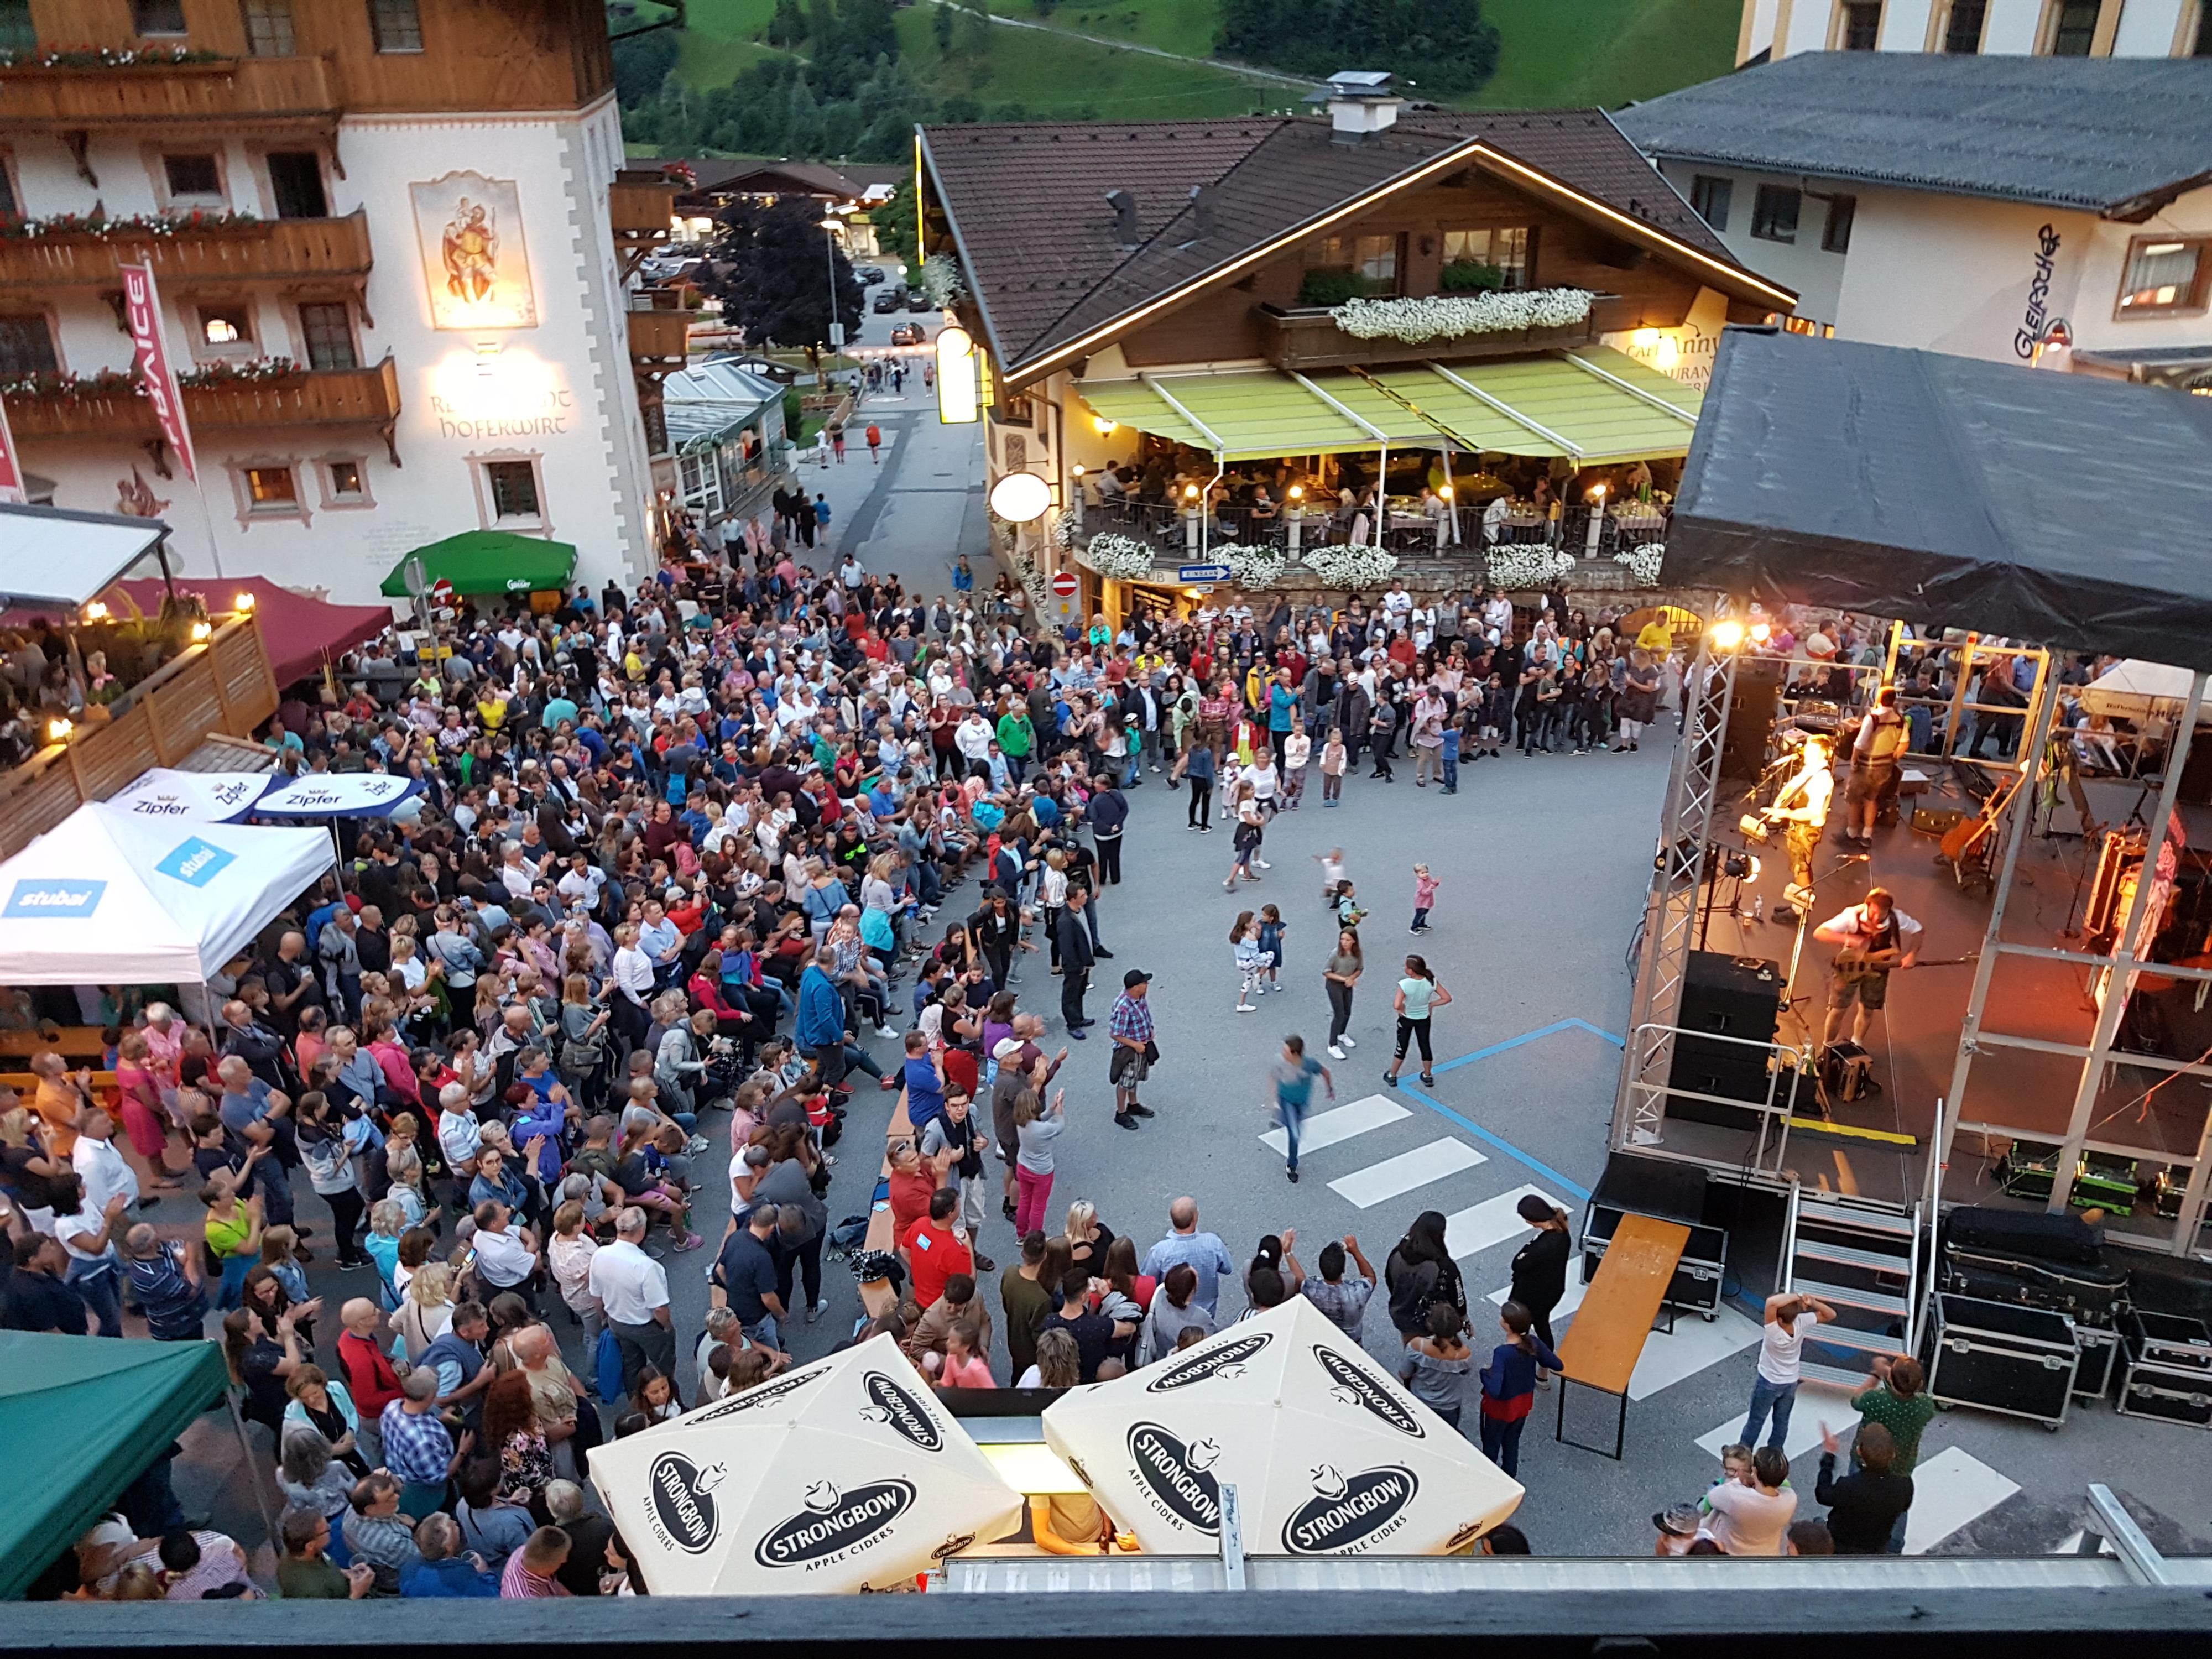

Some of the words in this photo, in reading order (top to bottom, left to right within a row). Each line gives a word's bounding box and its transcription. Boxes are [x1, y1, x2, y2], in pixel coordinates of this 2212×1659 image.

[133, 800, 190, 815] Zipfer
[286, 794, 342, 807] Zipfer
[180, 846, 217, 878] stubai
[19, 890, 92, 907] stubai
[1162, 1338, 1260, 1387] STRONGBOW
[873, 1379, 935, 1443] STRONGBOW
[1323, 1354, 1414, 1428] STRONGBOW
[657, 1463, 709, 1542] STRONGBOW
[1128, 1469, 1151, 1499] APPLE
[1151, 1499, 1185, 1531] CIDERS
[1137, 1434, 1219, 1523] STRONGBOW
[643, 1496, 656, 1523] APPLE
[653, 1523, 674, 1551] CIDERS
[773, 1488, 898, 1558] STRONGBOW
[1296, 1476, 1404, 1547] STRONGBOW
[1333, 1541, 1369, 1555] PPLE
[1371, 1515, 1407, 1543] CIDERS
[806, 1552, 846, 1572] APPLE
[851, 1526, 894, 1554] CIDERS
[936, 1538, 971, 1557] STRONGBOW
